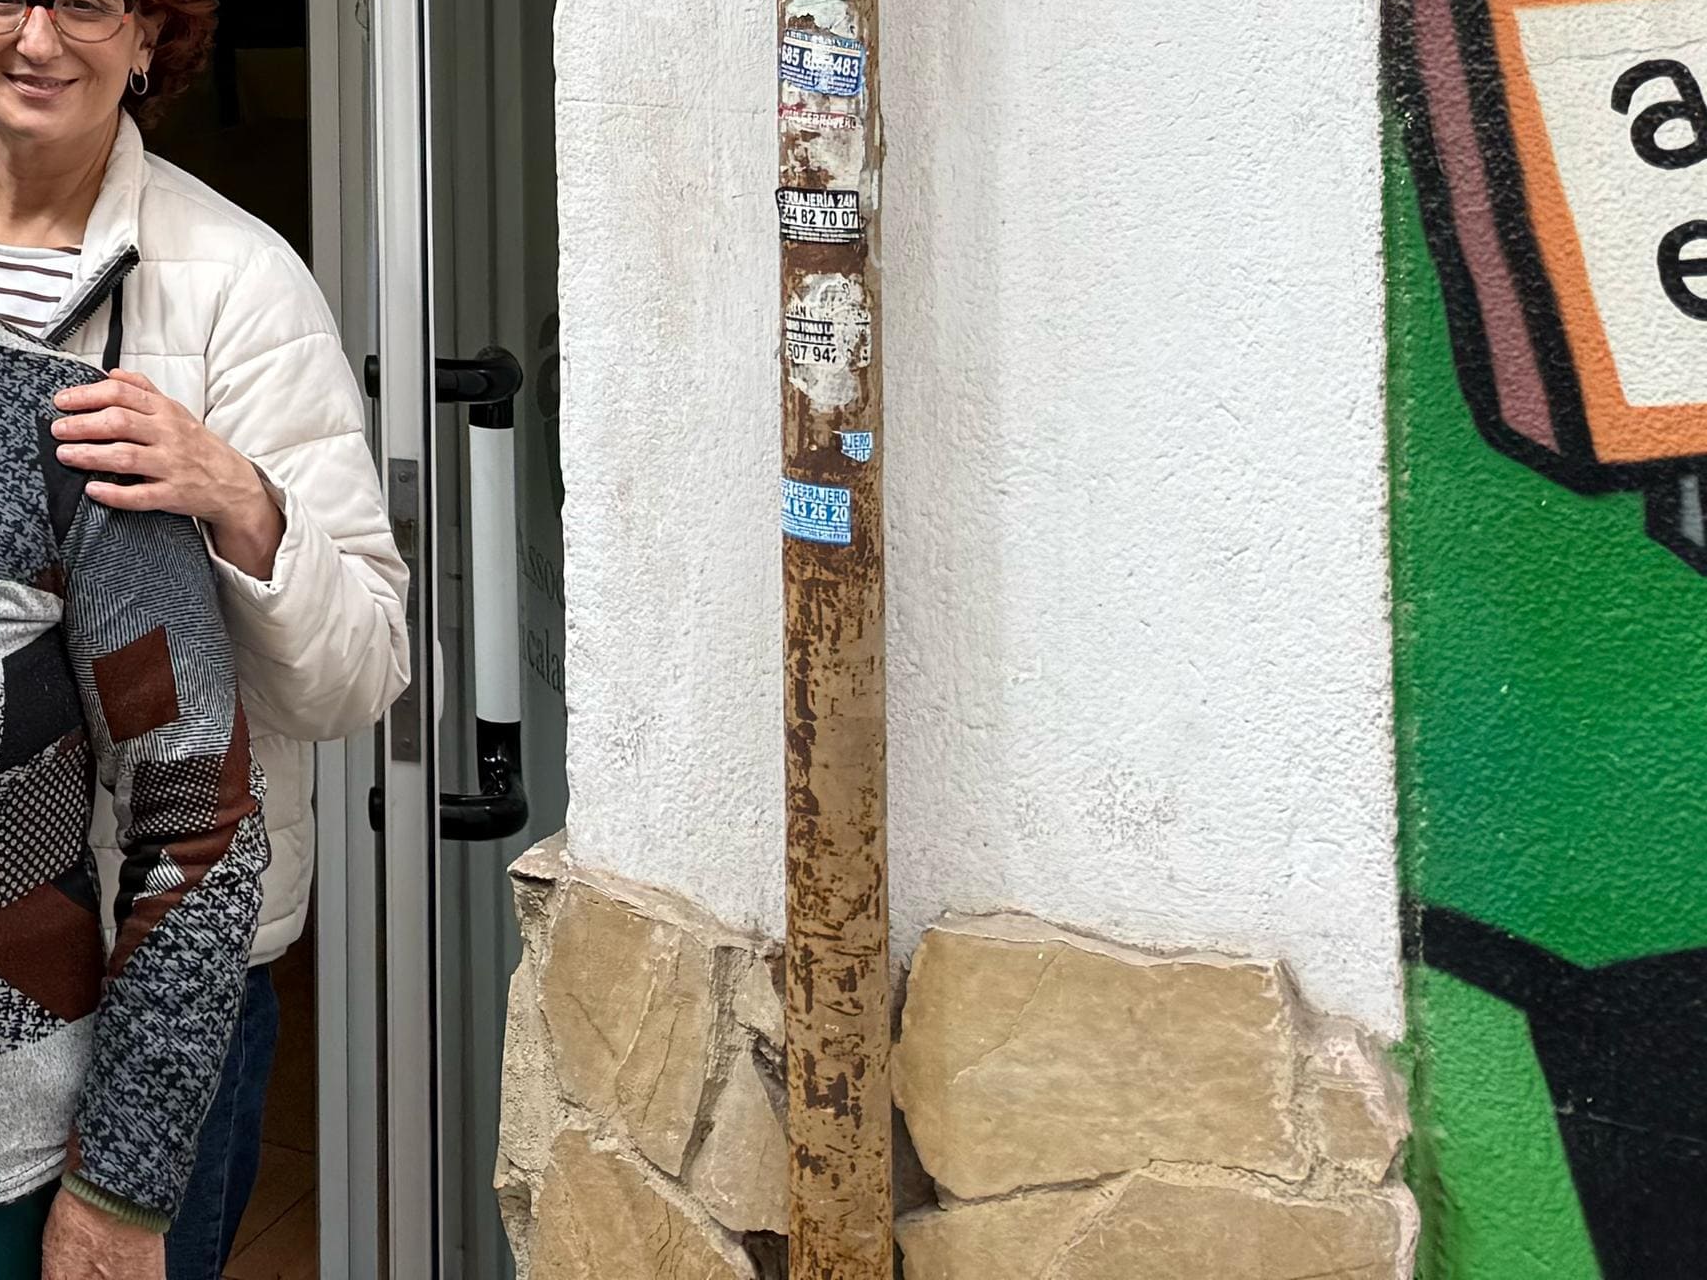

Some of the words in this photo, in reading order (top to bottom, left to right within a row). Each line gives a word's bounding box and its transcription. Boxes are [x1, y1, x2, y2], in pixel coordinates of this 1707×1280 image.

[801, 208, 817, 225] 82
[819, 210, 837, 227] 70
[841, 210, 858, 227] 07
[809, 502, 828, 521] 26
[830, 505, 848, 523] 20
